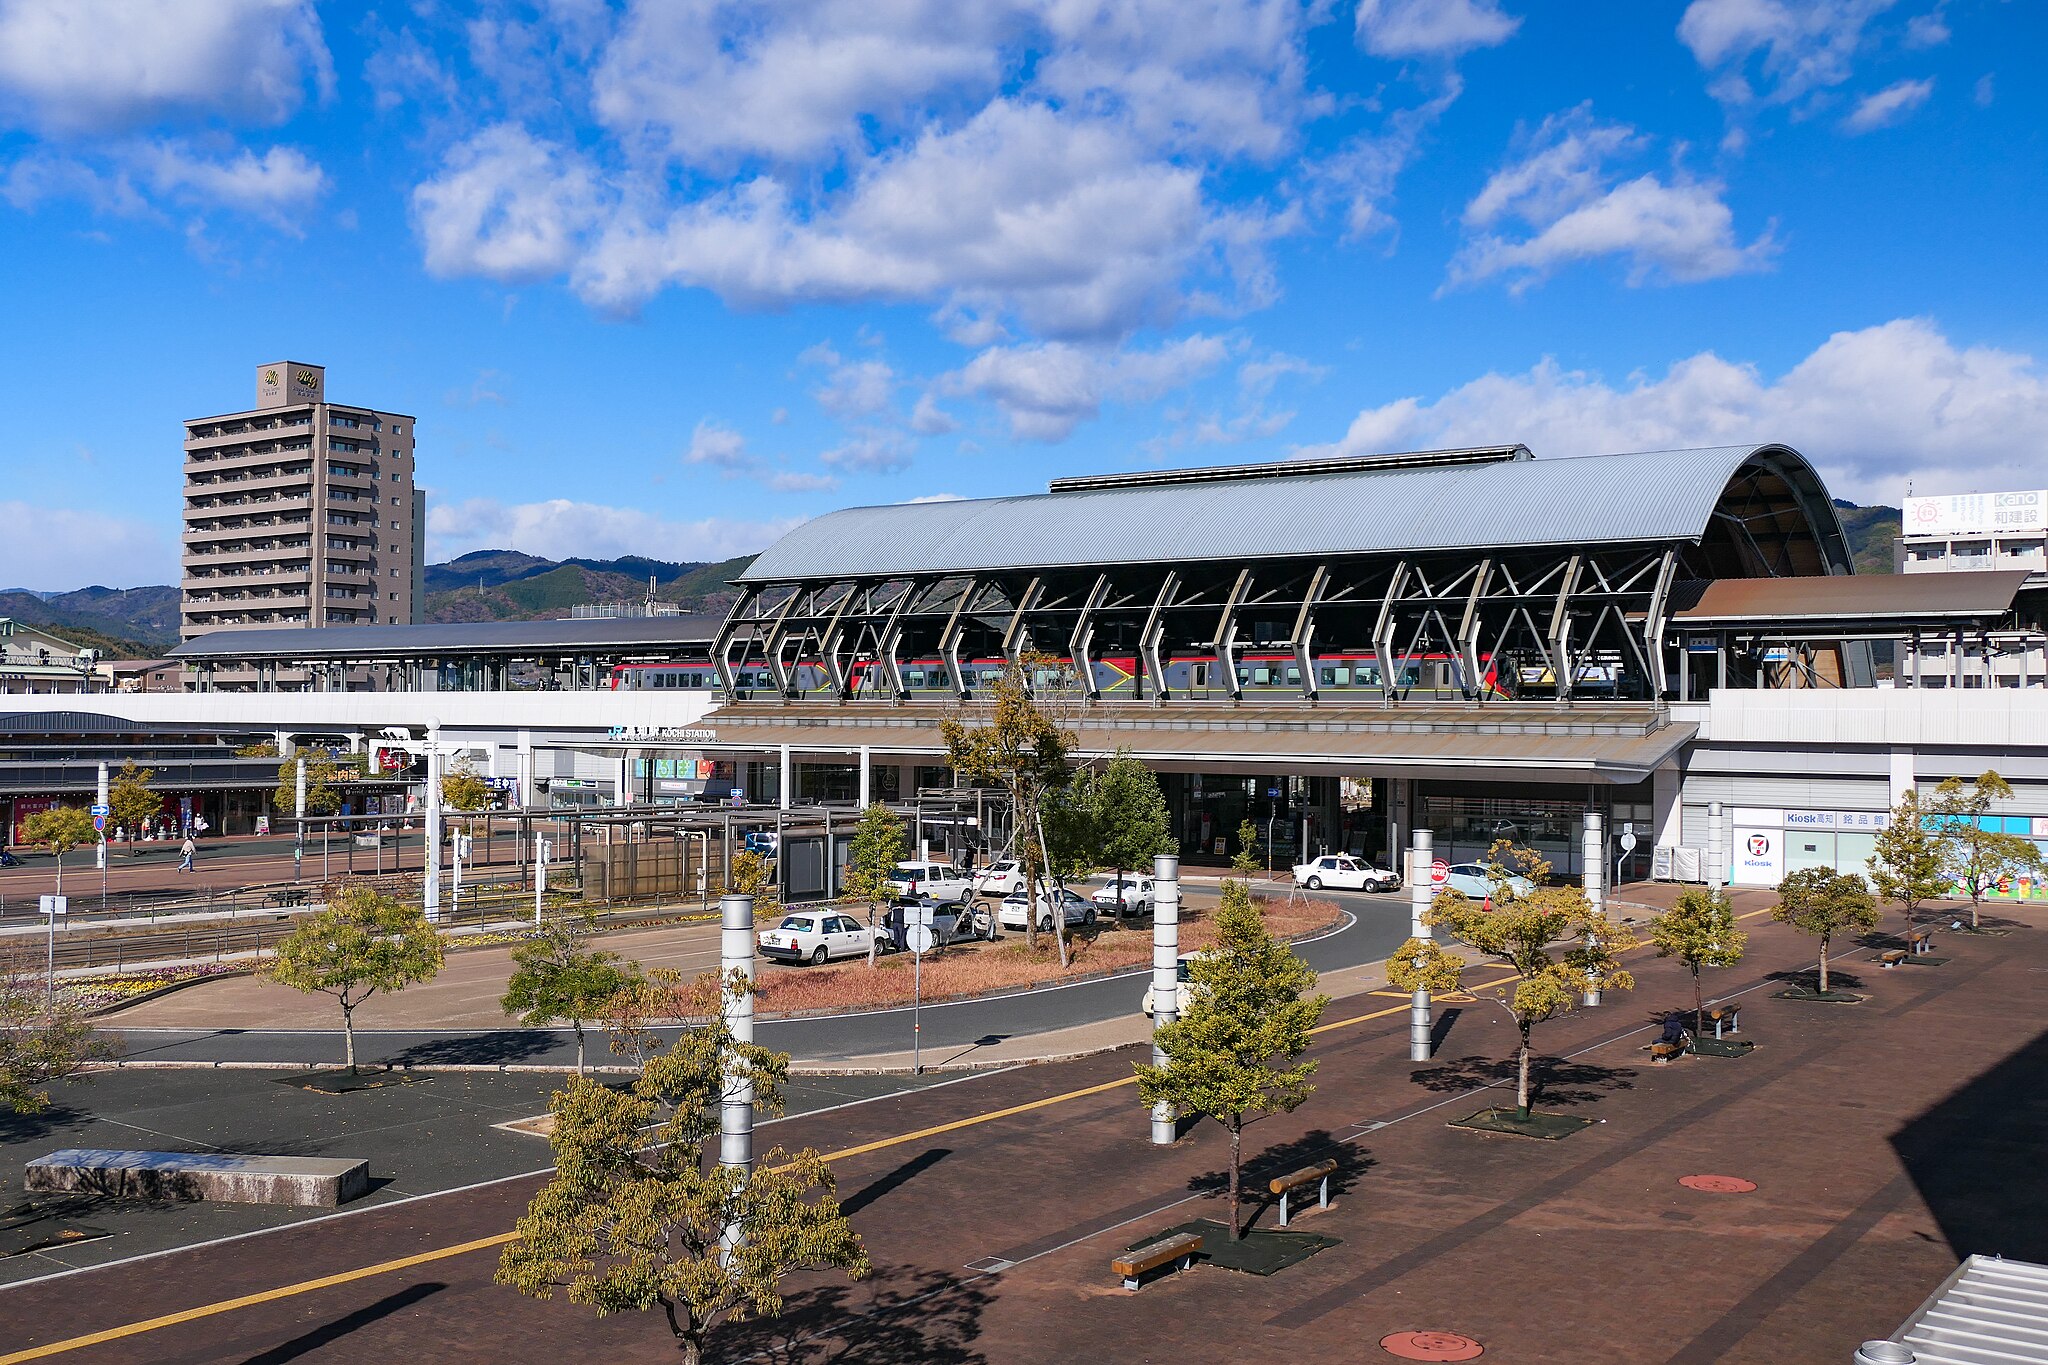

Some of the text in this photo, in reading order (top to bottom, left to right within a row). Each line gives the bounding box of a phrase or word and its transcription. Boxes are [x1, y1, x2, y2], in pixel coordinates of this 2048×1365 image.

[1995, 493, 2037, 507] Kano
[1994, 509, 2038, 524] 和建設
[608, 725, 623, 736] JR
[685, 729, 716, 738] STATION
[1842, 814, 1885, 826] 銘品館
[1744, 859, 1772, 867] Kiosk
